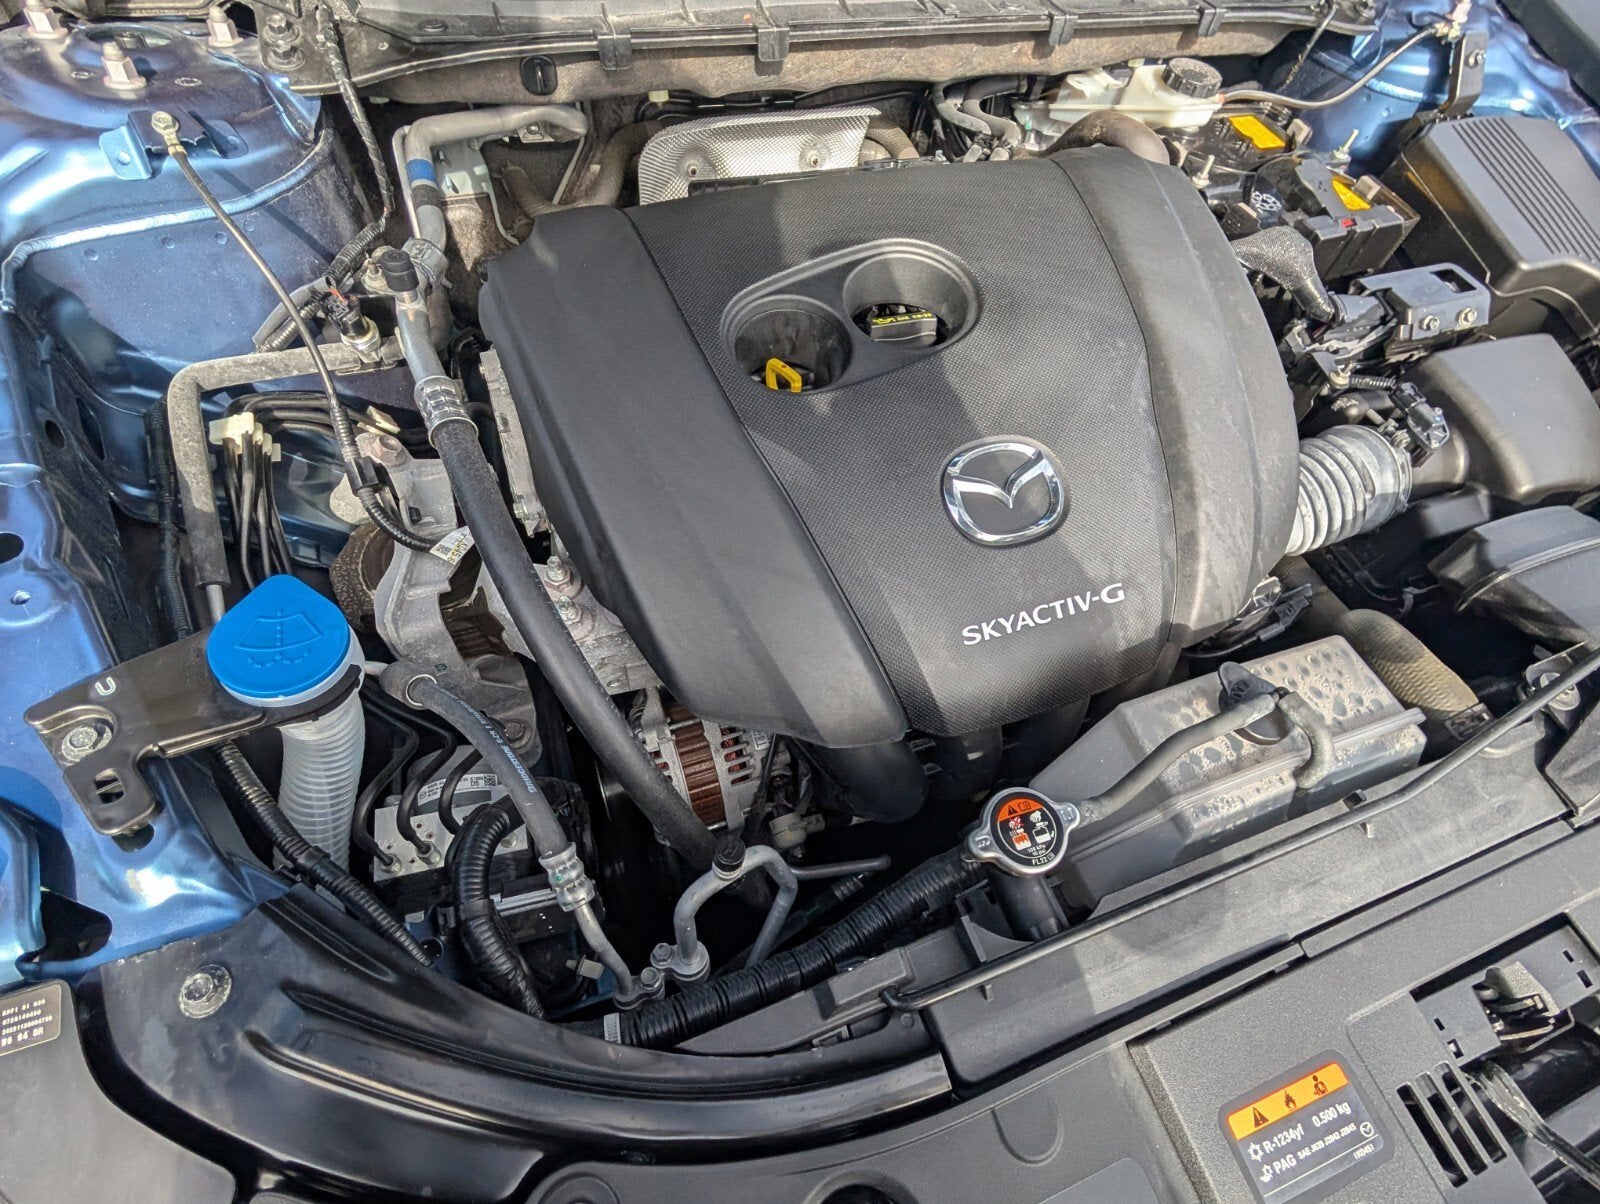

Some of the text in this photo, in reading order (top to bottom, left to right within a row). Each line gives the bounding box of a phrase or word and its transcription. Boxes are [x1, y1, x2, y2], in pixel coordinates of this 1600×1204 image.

[961, 582, 1125, 646] SKYACTIV-G
[502, 745, 537, 793] BRIDGESTONE
[1032, 856, 1048, 866] FL22
[1262, 1101, 1351, 1154] R-1234yf 0.500 kg
[1273, 1154, 1297, 1174] PAG
